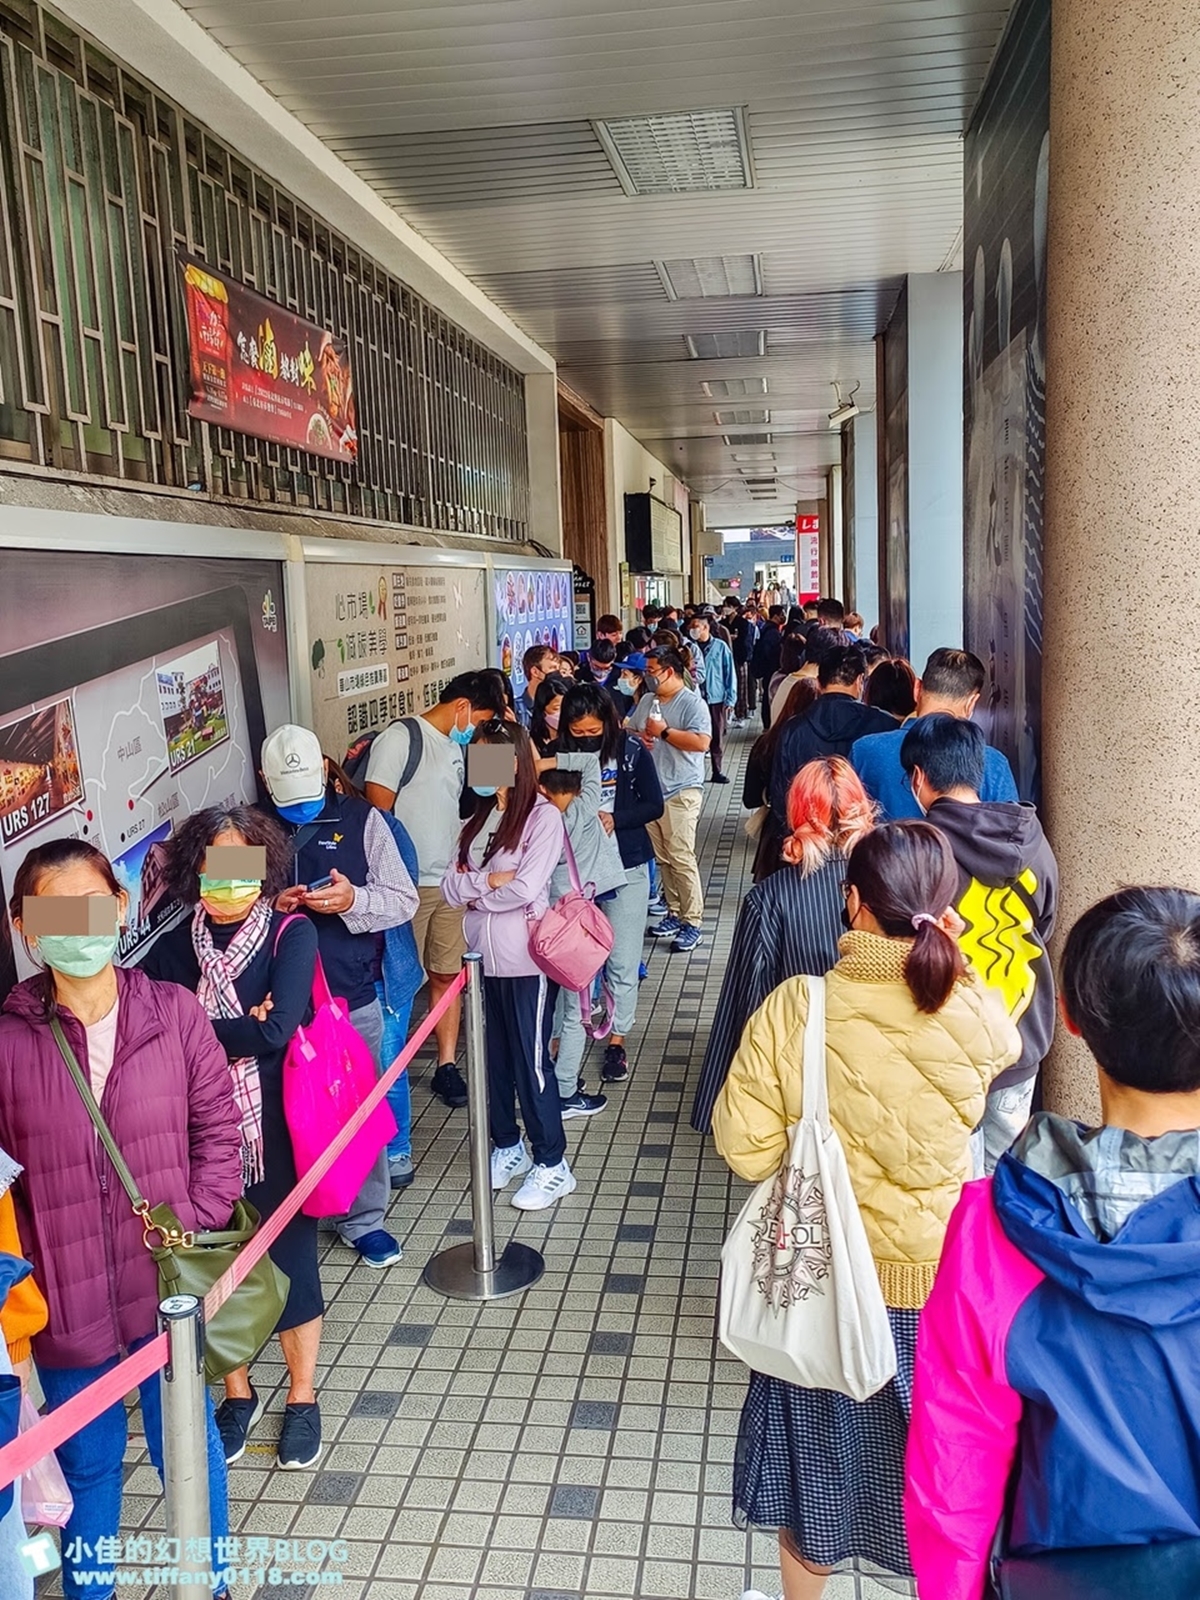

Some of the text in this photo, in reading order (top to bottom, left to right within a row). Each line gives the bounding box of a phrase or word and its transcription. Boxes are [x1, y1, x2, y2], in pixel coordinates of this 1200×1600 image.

[117, 735, 143, 762] 中山區
[170, 739, 196, 767] URS 21
[3, 806, 29, 837] URS
[31, 792, 50, 820] 127
[157, 791, 180, 819] 松山區
[127, 819, 146, 838] URS 27
[120, 915, 151, 955] URS 44
